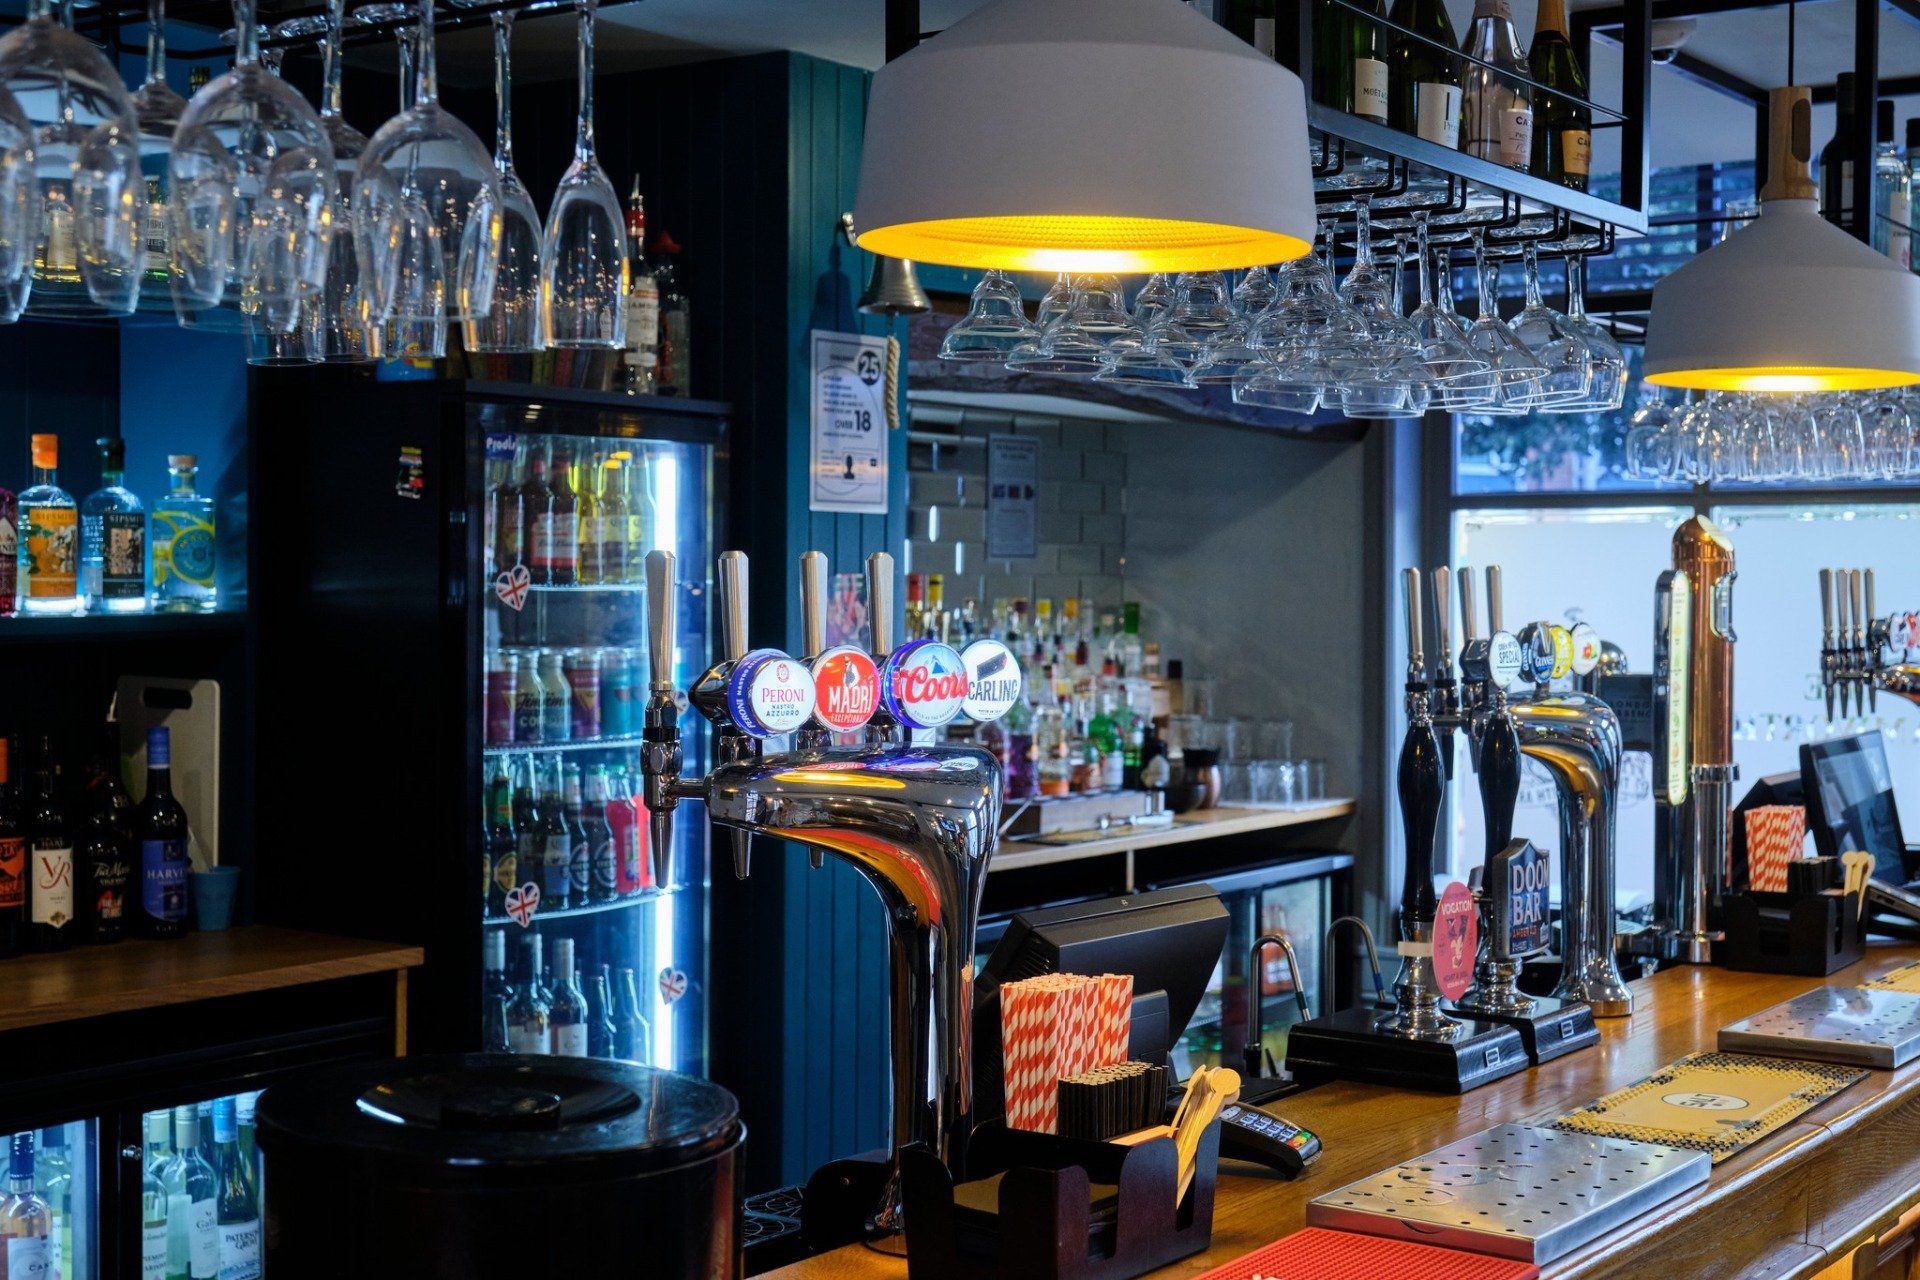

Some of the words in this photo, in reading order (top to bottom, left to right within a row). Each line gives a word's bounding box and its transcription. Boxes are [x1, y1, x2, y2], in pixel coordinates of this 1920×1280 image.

[856, 355, 882, 379] 25
[854, 410, 872, 432] 18
[762, 688, 805, 703] PERONI
[893, 666, 969, 704] Coors
[968, 679, 1018, 702] CARLING
[736, 699, 756, 729] PERONI
[1441, 899, 1473, 916] VOCATION
[1512, 891, 1542, 927] BAR
